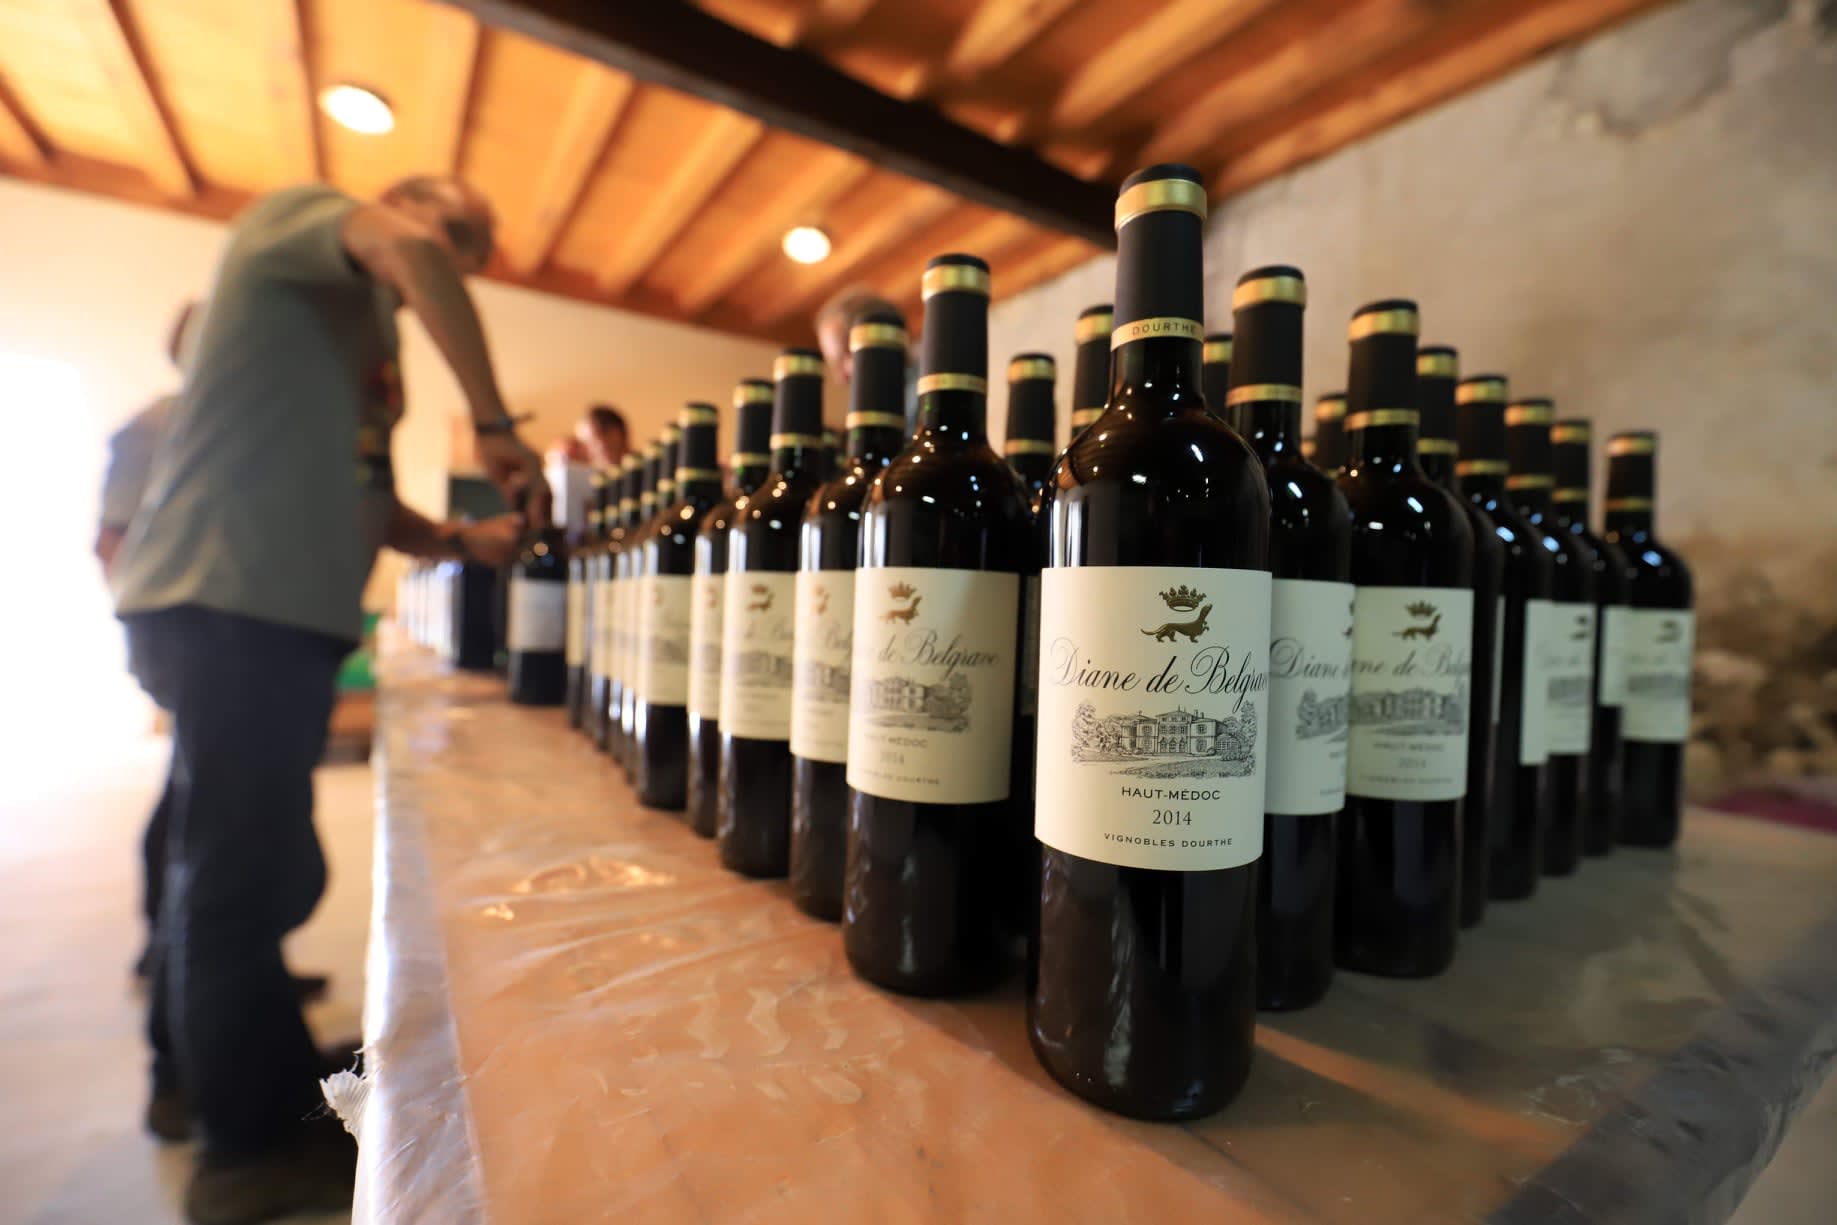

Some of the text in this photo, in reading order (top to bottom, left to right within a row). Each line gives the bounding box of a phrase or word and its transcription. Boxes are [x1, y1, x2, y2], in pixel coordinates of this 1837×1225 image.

[1132, 321, 1197, 336] DOURTHE
[1049, 637, 1142, 692] Diane
[1145, 655, 1185, 694] de
[1121, 786, 1221, 801] HAUT-MÉDOC
[1152, 809, 1192, 826] 2014
[1104, 832, 1233, 848] VIGNOBLES DOURTHE
